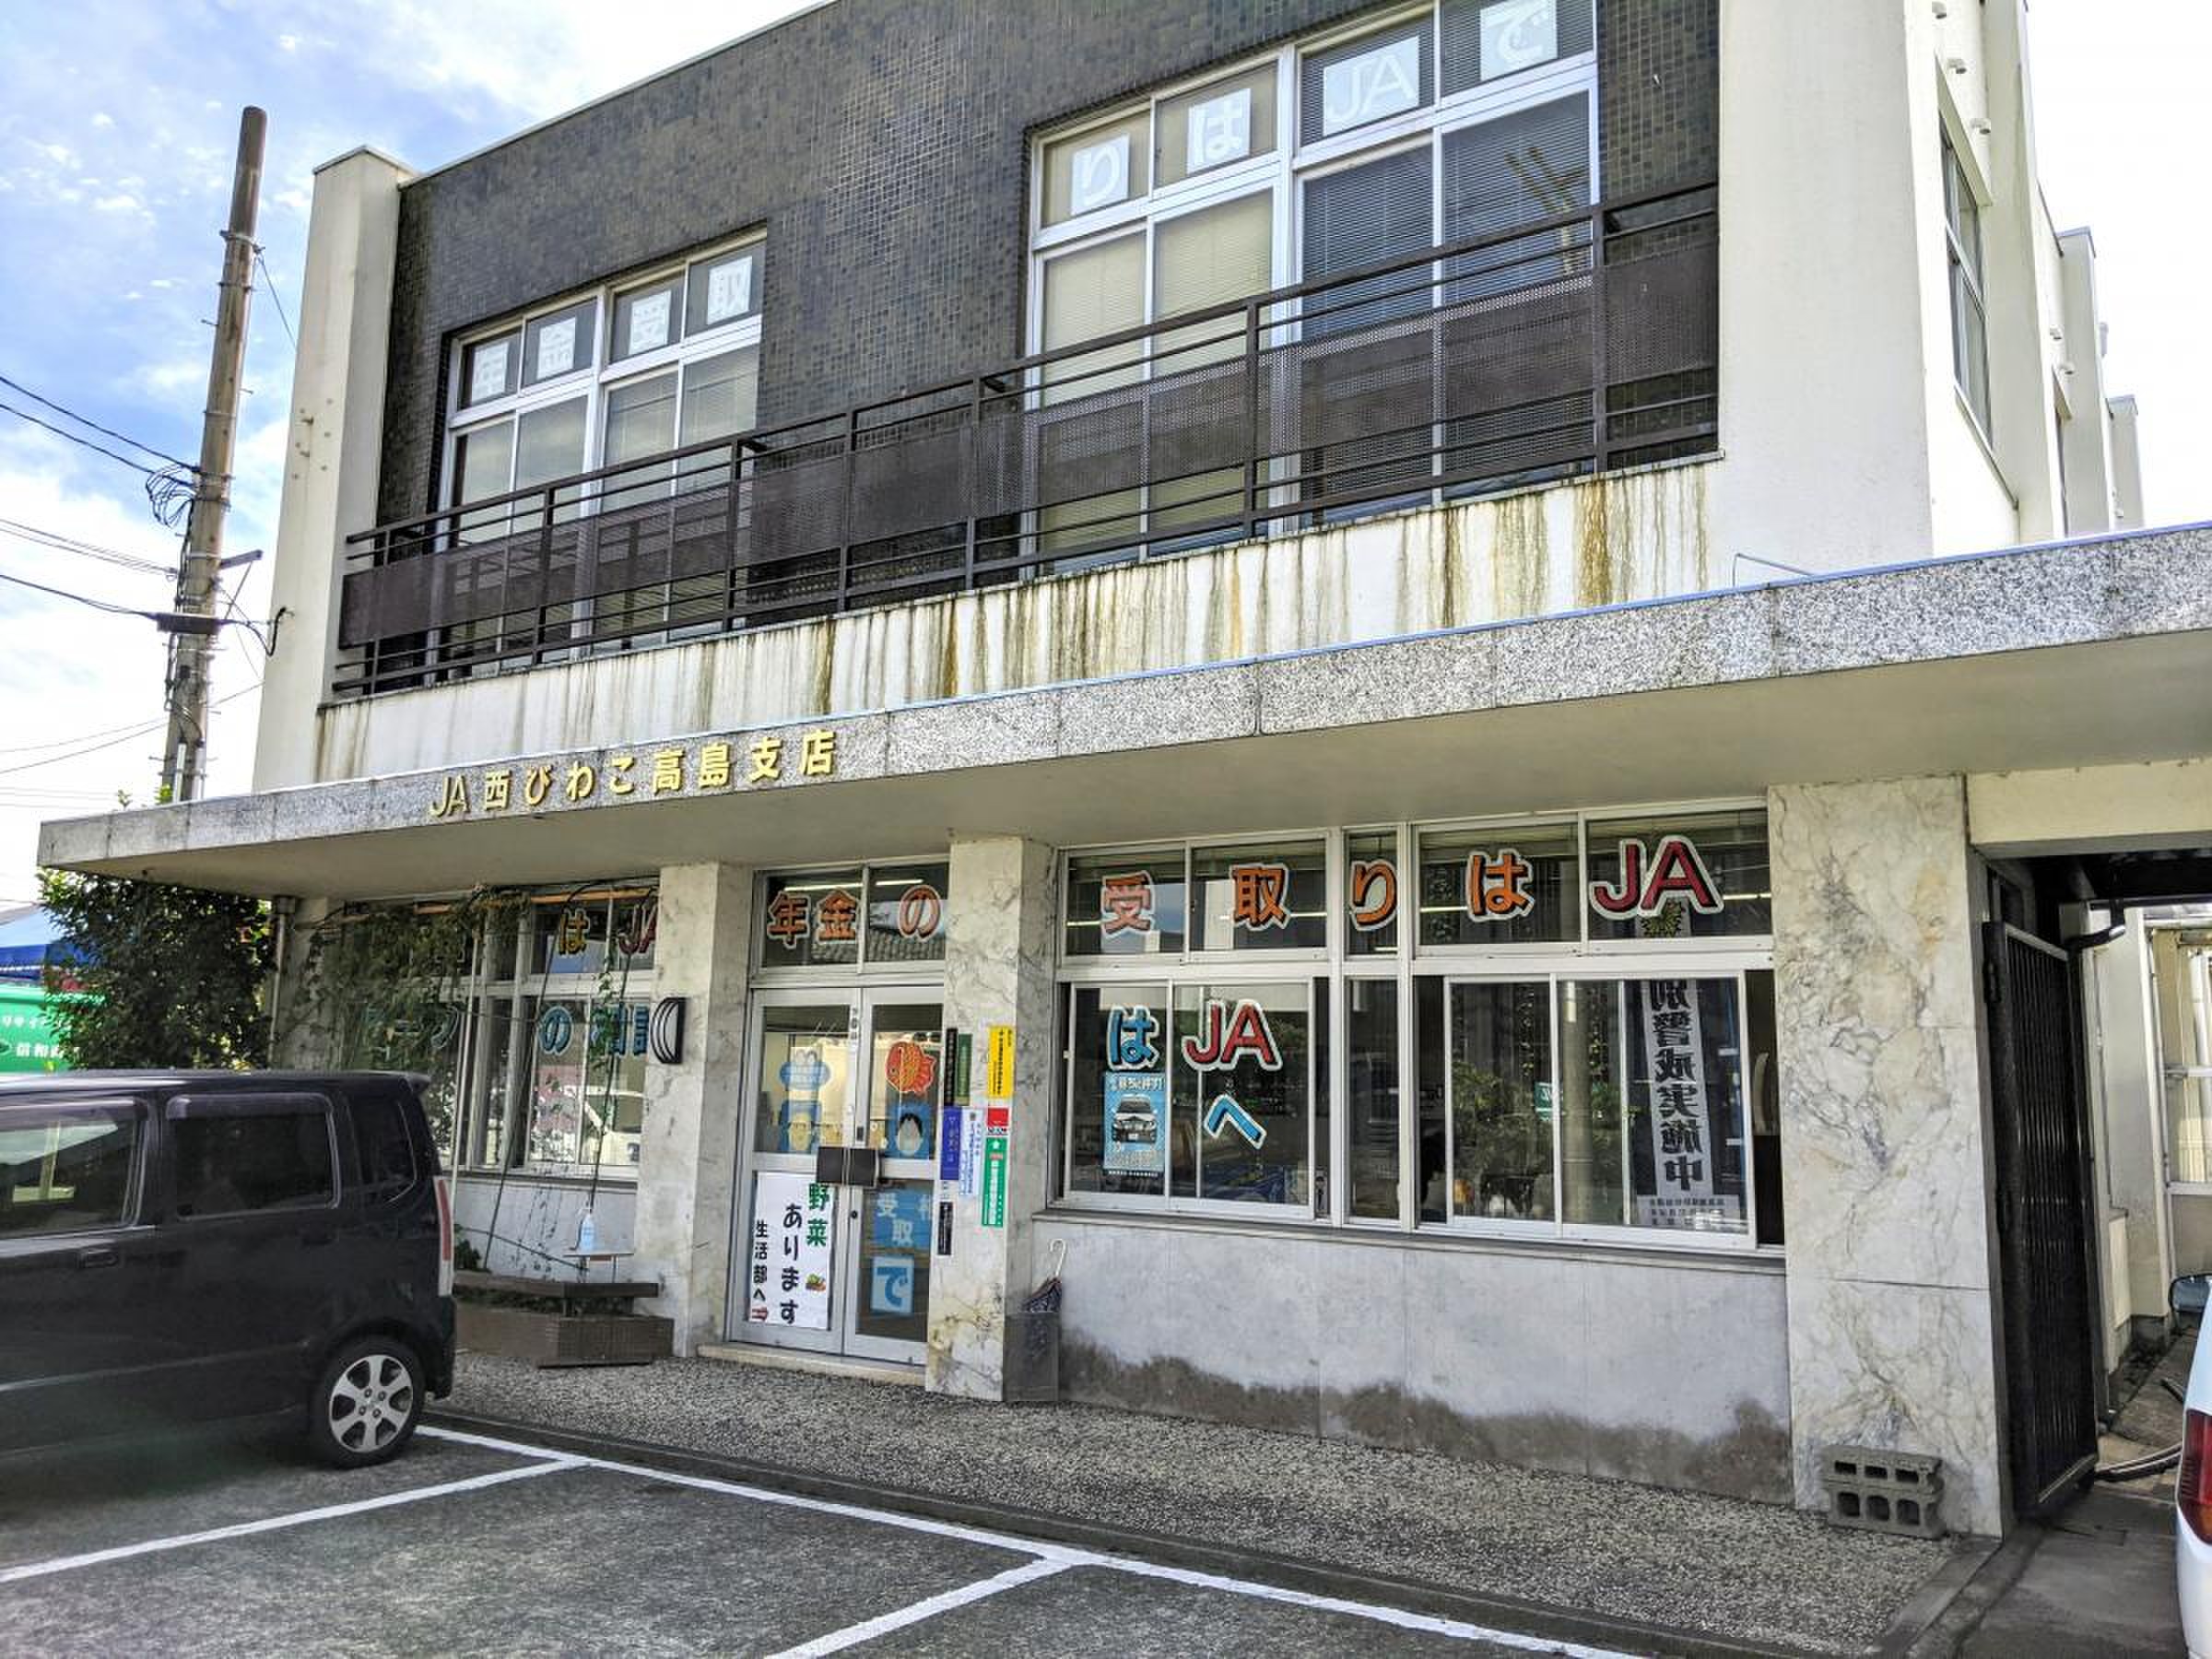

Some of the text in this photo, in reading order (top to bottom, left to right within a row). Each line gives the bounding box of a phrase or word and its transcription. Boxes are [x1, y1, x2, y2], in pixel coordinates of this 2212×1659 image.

[430, 731, 836, 818] JA西びわこ高島支店
[767, 886, 942, 949] 年金の
[805, 1182, 831, 1247] 野菜
[780, 1204, 804, 1325] あります
